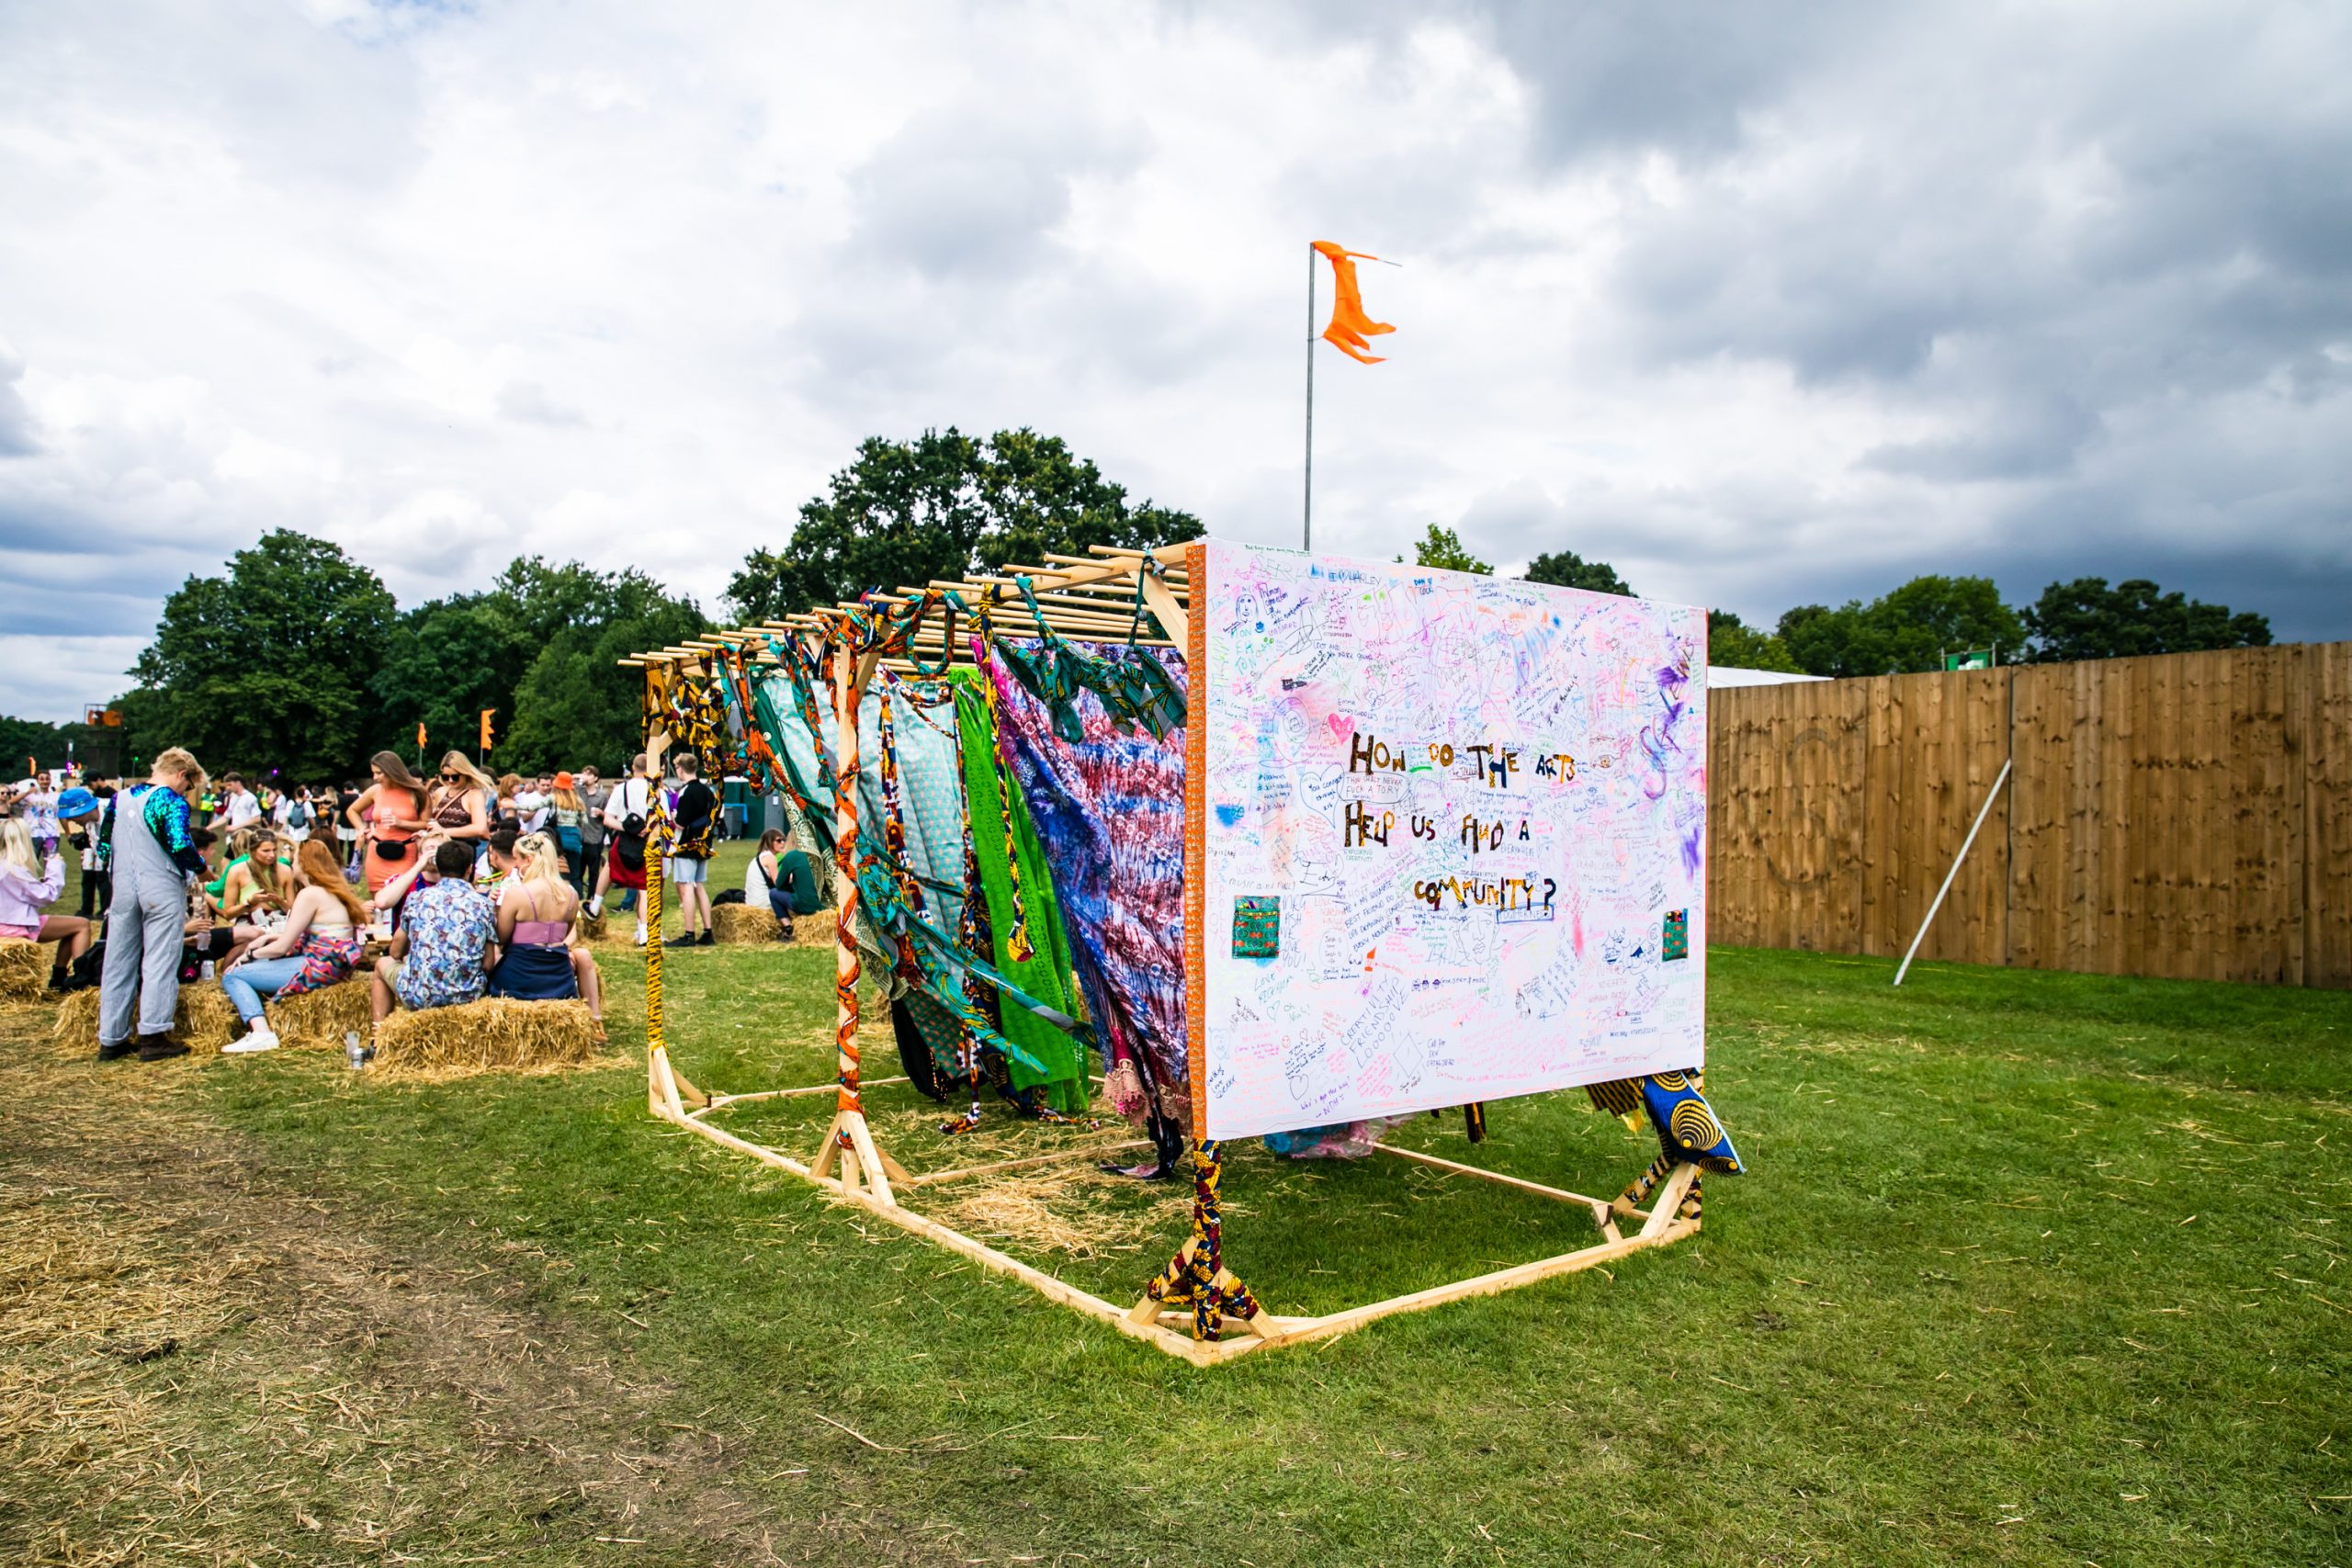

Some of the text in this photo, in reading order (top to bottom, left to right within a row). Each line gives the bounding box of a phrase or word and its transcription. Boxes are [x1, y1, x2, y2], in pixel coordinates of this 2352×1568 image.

[1350, 731, 1407, 776] HOW
[1427, 742, 1454, 767] DO
[1466, 742, 1520, 789] THE
[1535, 753, 1576, 784] ARTS
[1346, 785, 1400, 796] FUCK A TORY
[1344, 800, 1530, 853] HELP US FIND A
[1344, 912, 1361, 928] BEST
[1372, 920, 1394, 941] MONDAY
[1340, 974, 1388, 1046] CREATIVITY
[1349, 976, 1399, 1054] FRIENDSHIP
